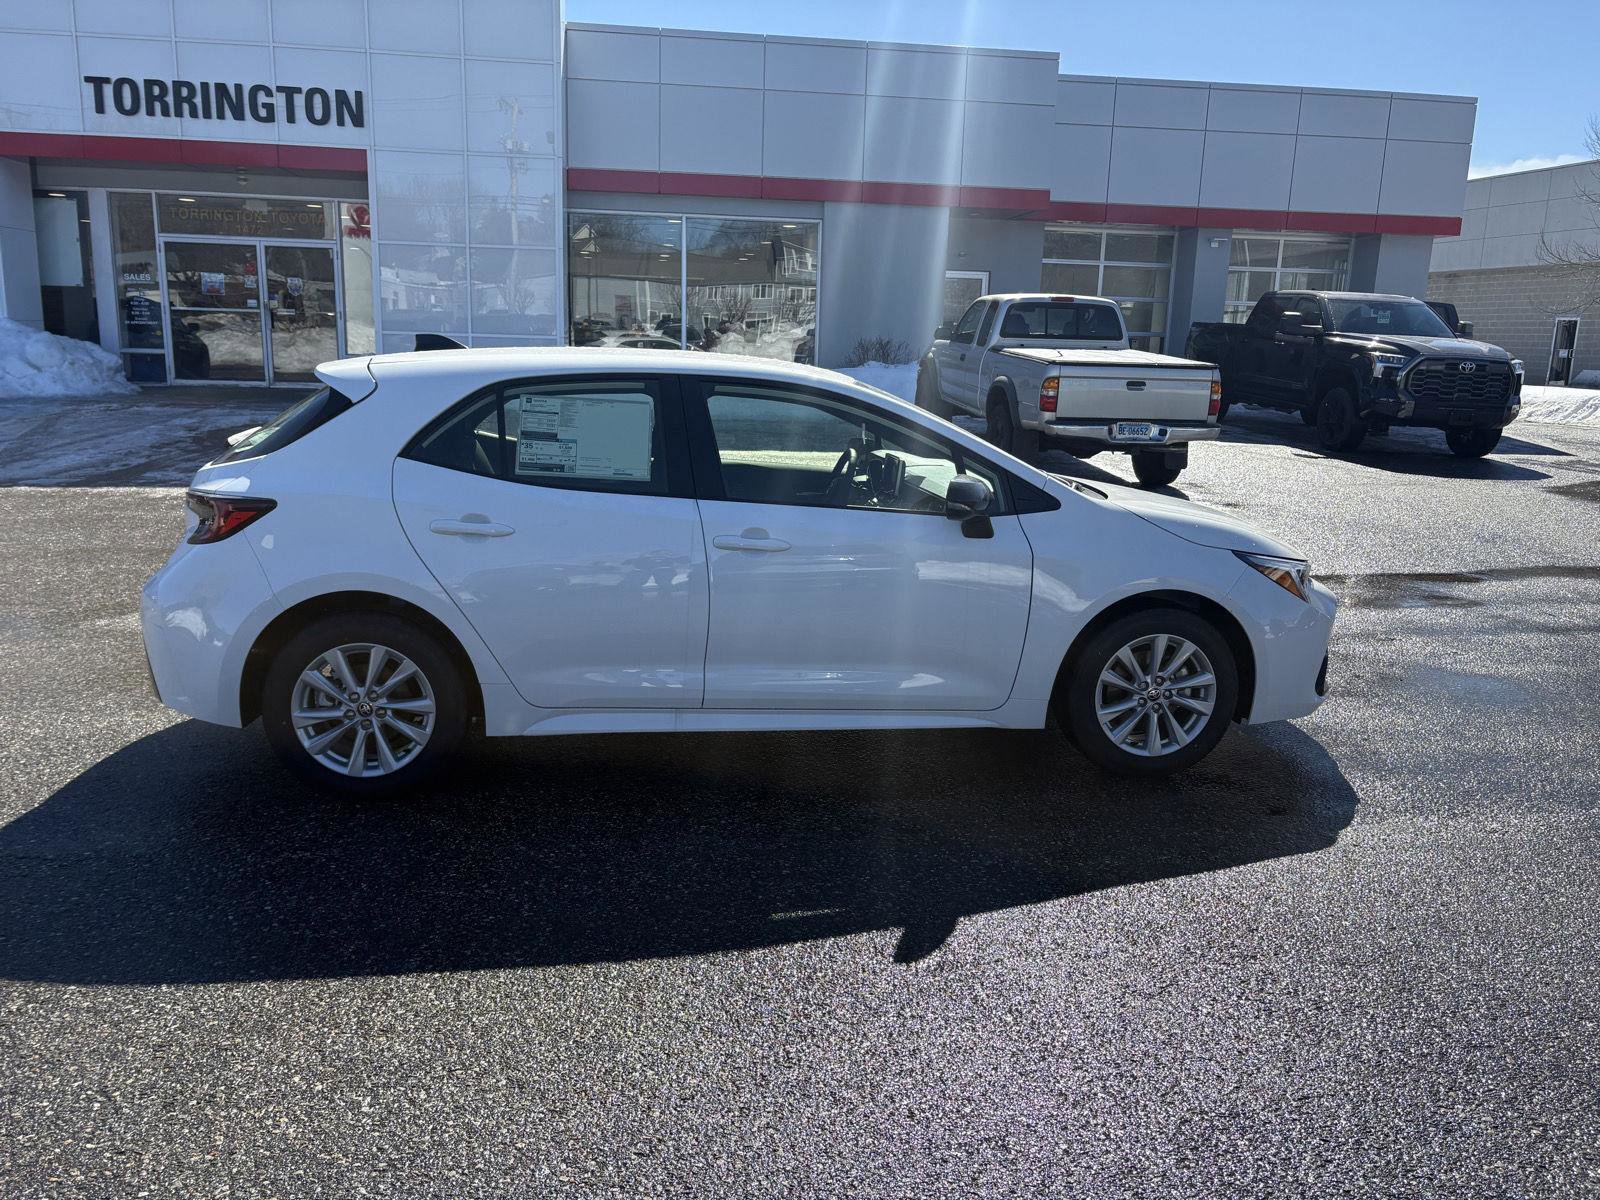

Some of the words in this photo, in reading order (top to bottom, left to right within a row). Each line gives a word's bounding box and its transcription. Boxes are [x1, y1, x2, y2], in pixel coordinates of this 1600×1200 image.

[84, 76, 364, 128] TORRINGTON
[169, 206, 264, 222] TORRINGTON
[271, 209, 325, 224] TOYOTA
[123, 273, 151, 281] SALES
